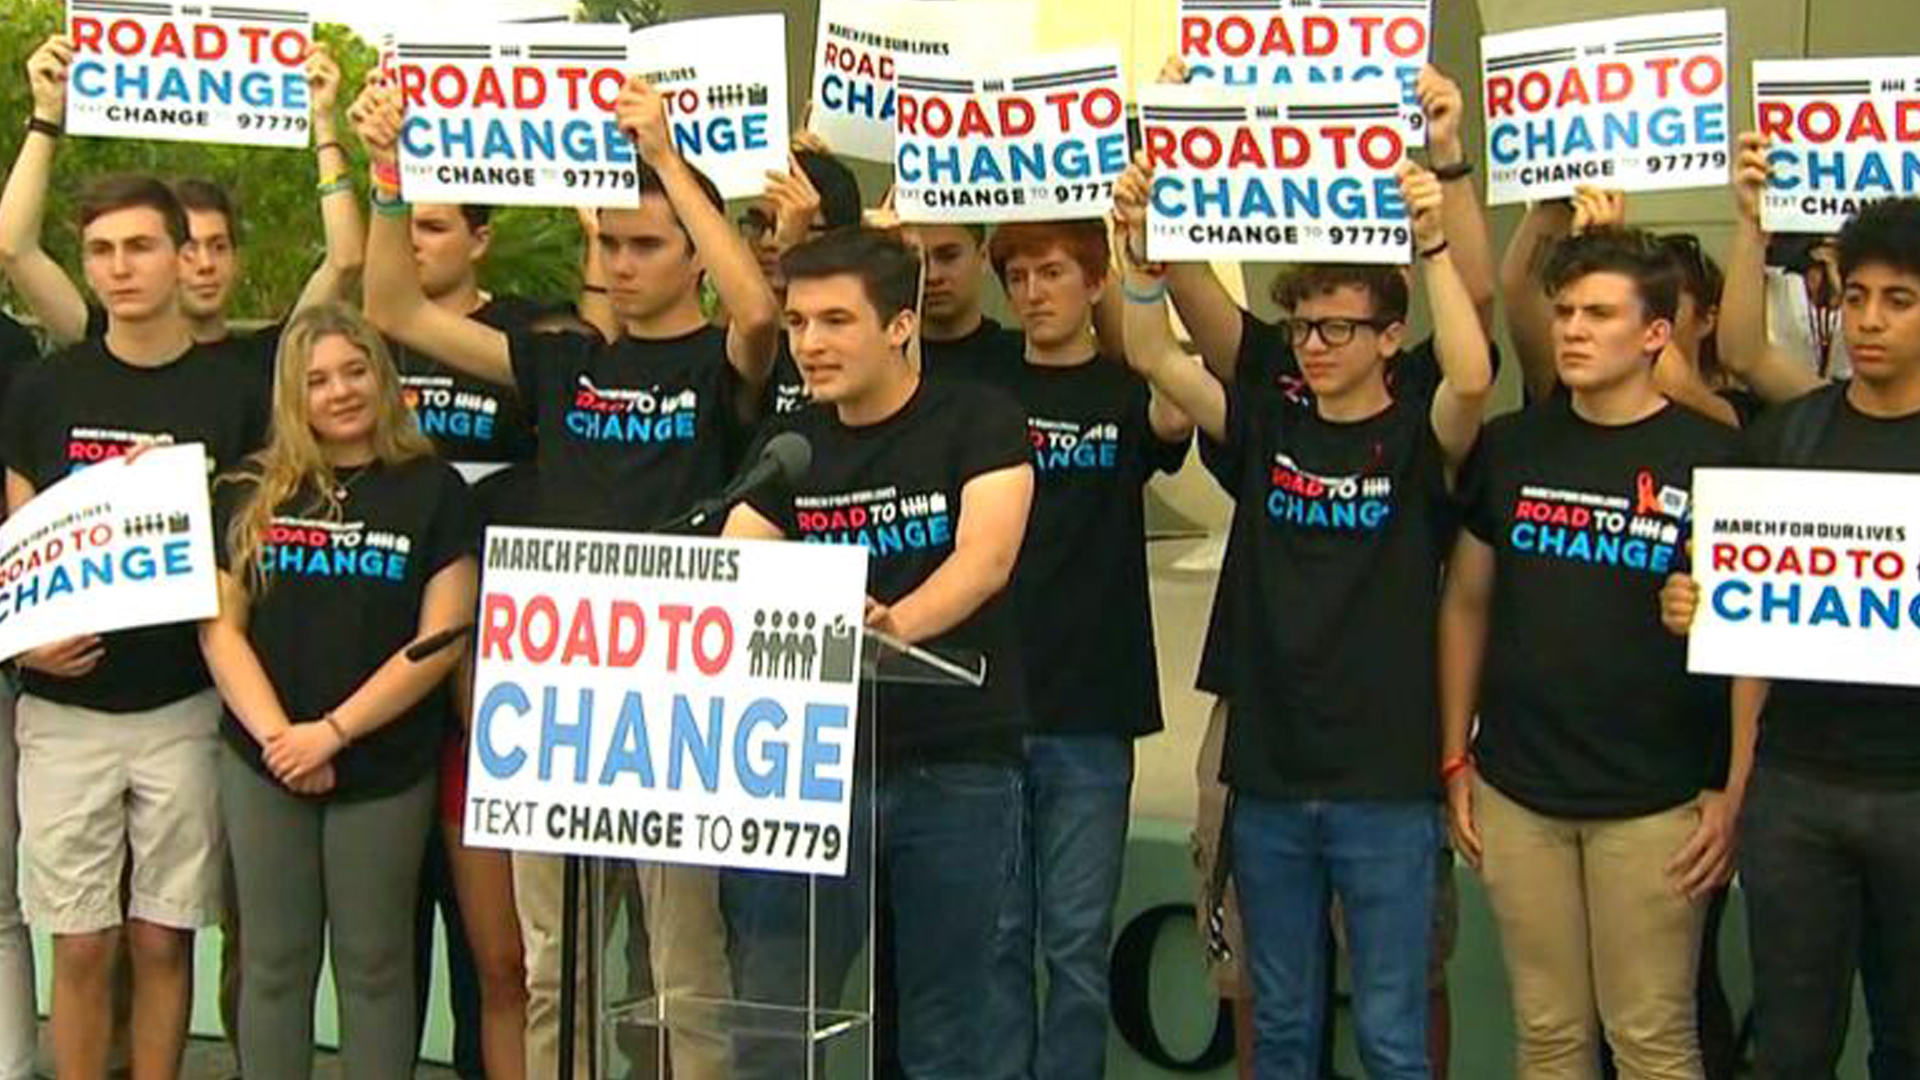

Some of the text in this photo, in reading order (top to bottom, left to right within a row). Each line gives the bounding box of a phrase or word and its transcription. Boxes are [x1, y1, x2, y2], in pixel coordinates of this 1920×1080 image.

[72, 16, 310, 66] ROAD TO
[1181, 16, 1427, 58] ROAD TO
[825, 41, 894, 81] ROAD
[72, 61, 309, 108] CHANGE
[400, 64, 547, 110] ROAD
[557, 66, 630, 112] TO
[660, 88, 700, 117] TO
[1487, 54, 1724, 119] ROAD TO
[106, 105, 210, 126] CHANGE
[237, 113, 308, 132] 97779
[897, 87, 1123, 138] ROAD TO
[402, 116, 633, 163] CHANGE
[672, 112, 769, 156] NGE
[1144, 125, 1404, 170] ROAD TO
[1489, 103, 1727, 165] CHANGE
[436, 165, 536, 187] CHANGE
[563, 169, 636, 188] 97779
[898, 133, 1128, 185] CHANGE
[1519, 157, 1615, 186] CHANGE
[1645, 150, 1727, 174] 97779
[922, 188, 1026, 208] CHANGE
[1054, 181, 1114, 204] 9777
[1152, 176, 1410, 220] CHANGE
[1188, 224, 1299, 245] CHANGE
[1328, 225, 1409, 245] 97779
[423, 388, 451, 408] TO
[418, 408, 494, 440] NGE
[565, 410, 696, 441] CHANGE
[1047, 431, 1078, 452] TO
[69, 441, 122, 460] ROA
[797, 501, 897, 531] ROAD TO
[1267, 489, 1390, 527] CHANG
[1515, 501, 1626, 533] ROAD TO
[71, 523, 113, 551] TO
[330, 531, 363, 548] TO
[1511, 521, 1674, 572] CHANGE
[487, 536, 572, 573] MARCH
[573, 540, 621, 577] FOR
[674, 546, 741, 583] LIVES
[1712, 542, 1906, 582] ROAD TO
[480, 592, 735, 677] ROAD TO
[474, 680, 850, 803] CHANGE
[471, 797, 842, 863] TEXT CHANGE TO 97779
